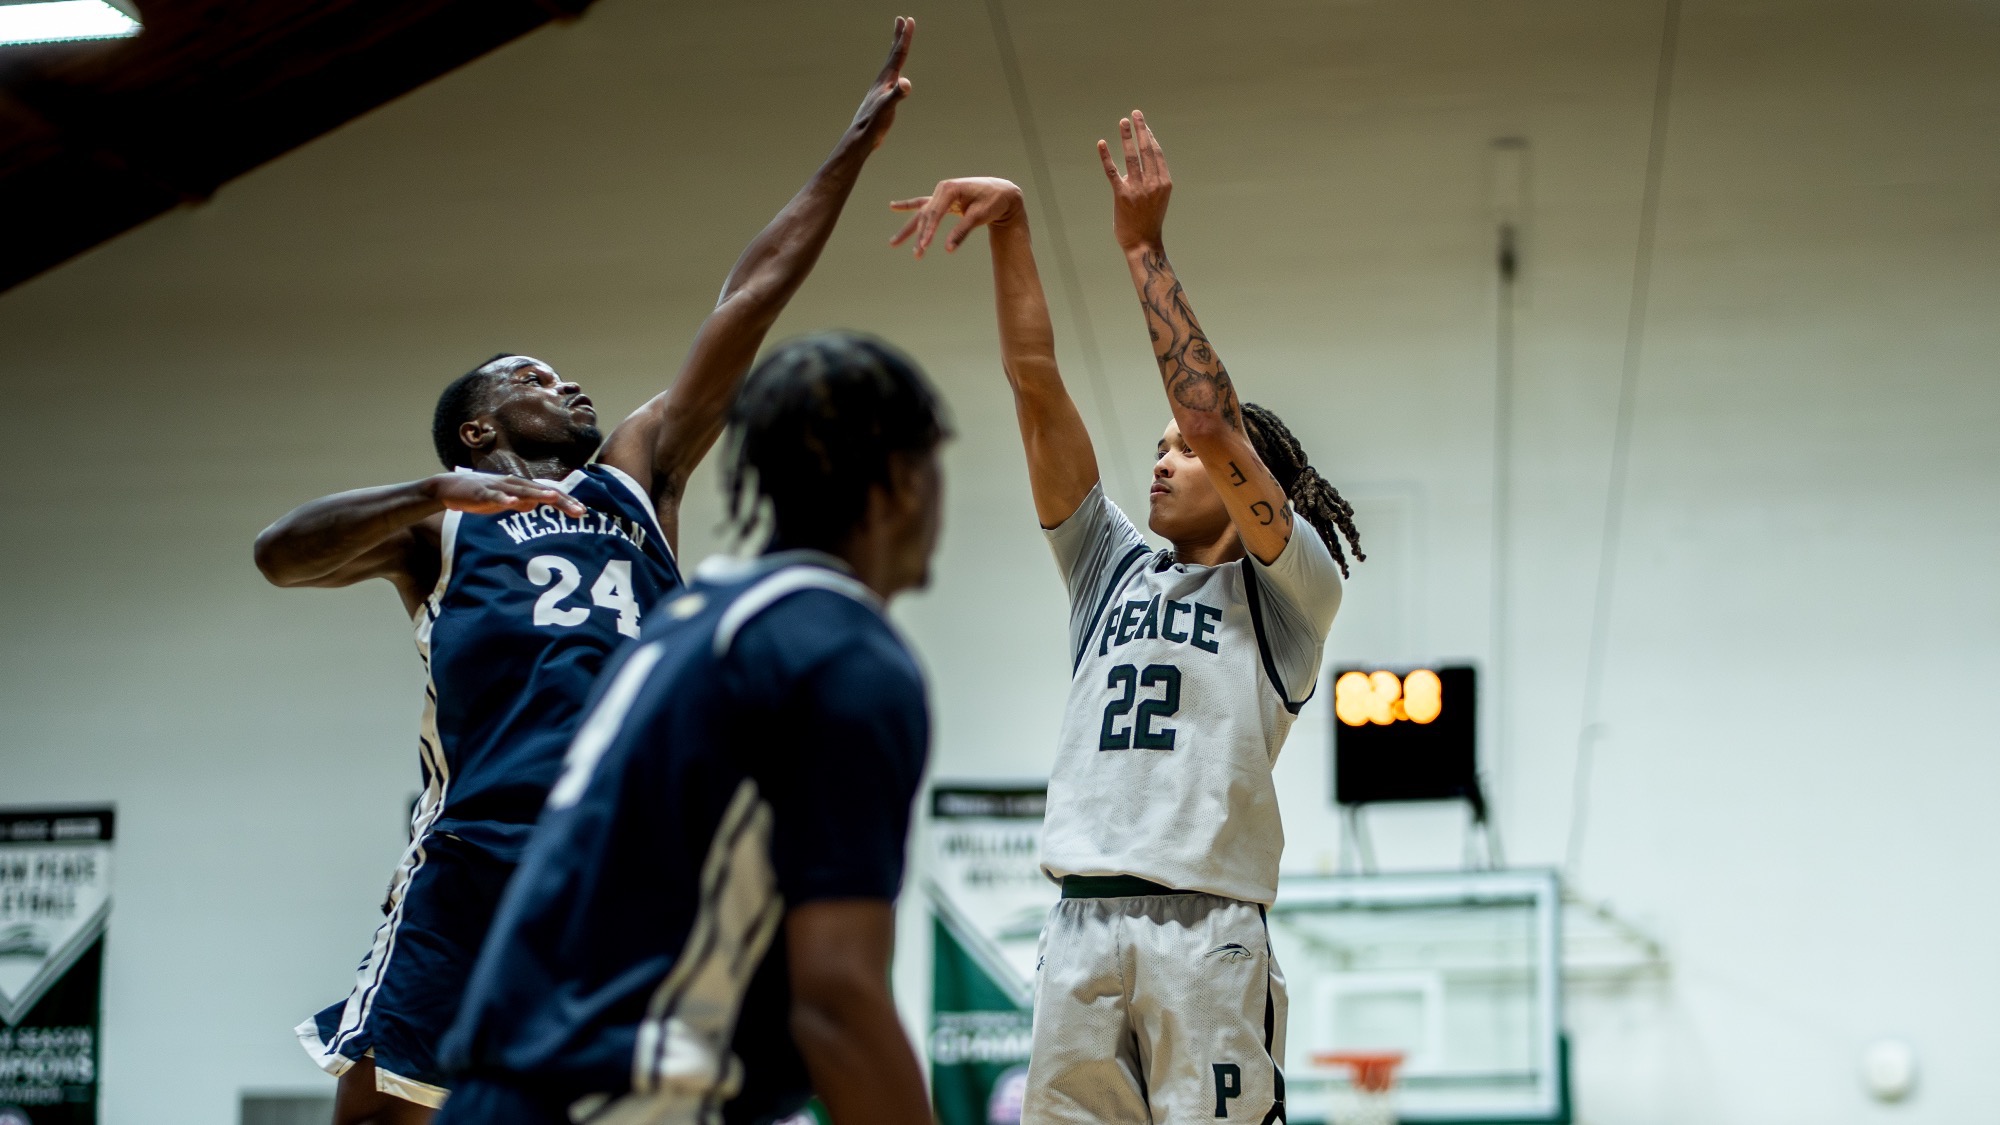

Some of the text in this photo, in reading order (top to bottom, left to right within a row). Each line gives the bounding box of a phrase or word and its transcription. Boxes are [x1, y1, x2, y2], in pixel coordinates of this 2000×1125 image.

[526, 554, 642, 640] 24
[1098, 593, 1223, 655] PEACE
[1098, 663, 1182, 752] 22
[1212, 1063, 1242, 1118] P
